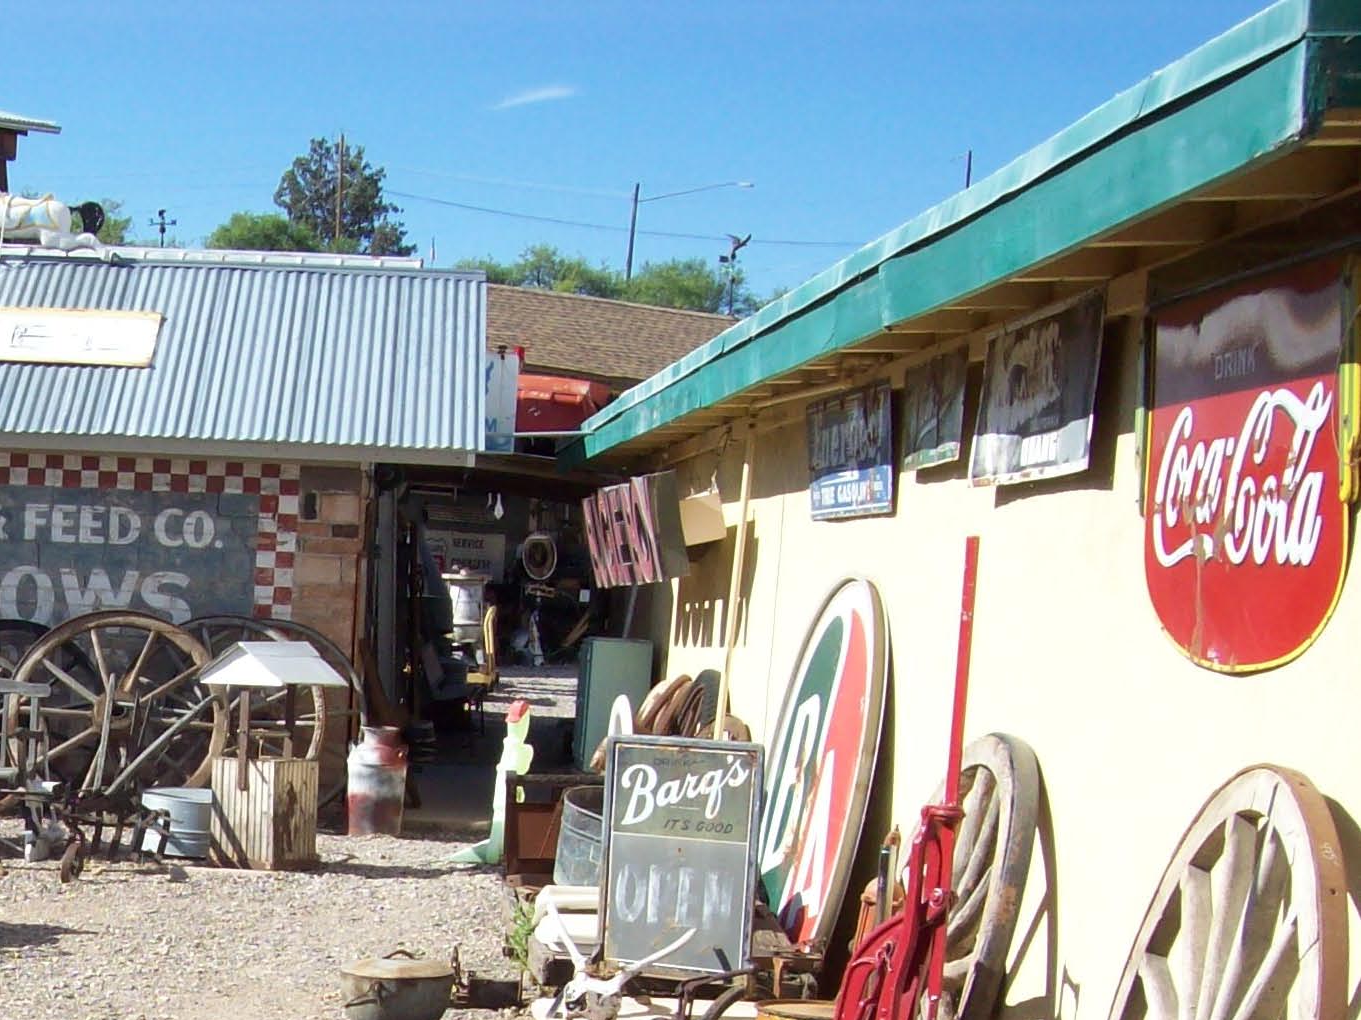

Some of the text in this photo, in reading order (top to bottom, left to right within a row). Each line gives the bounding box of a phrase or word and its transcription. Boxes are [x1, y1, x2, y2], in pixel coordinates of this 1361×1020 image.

[1154, 382, 1333, 567] Coca-Cola
[23, 502, 141, 545] FEED
[154, 508, 223, 549] CO.
[621, 755, 750, 825] Barq's
[696, 821, 734, 834] GOOD
